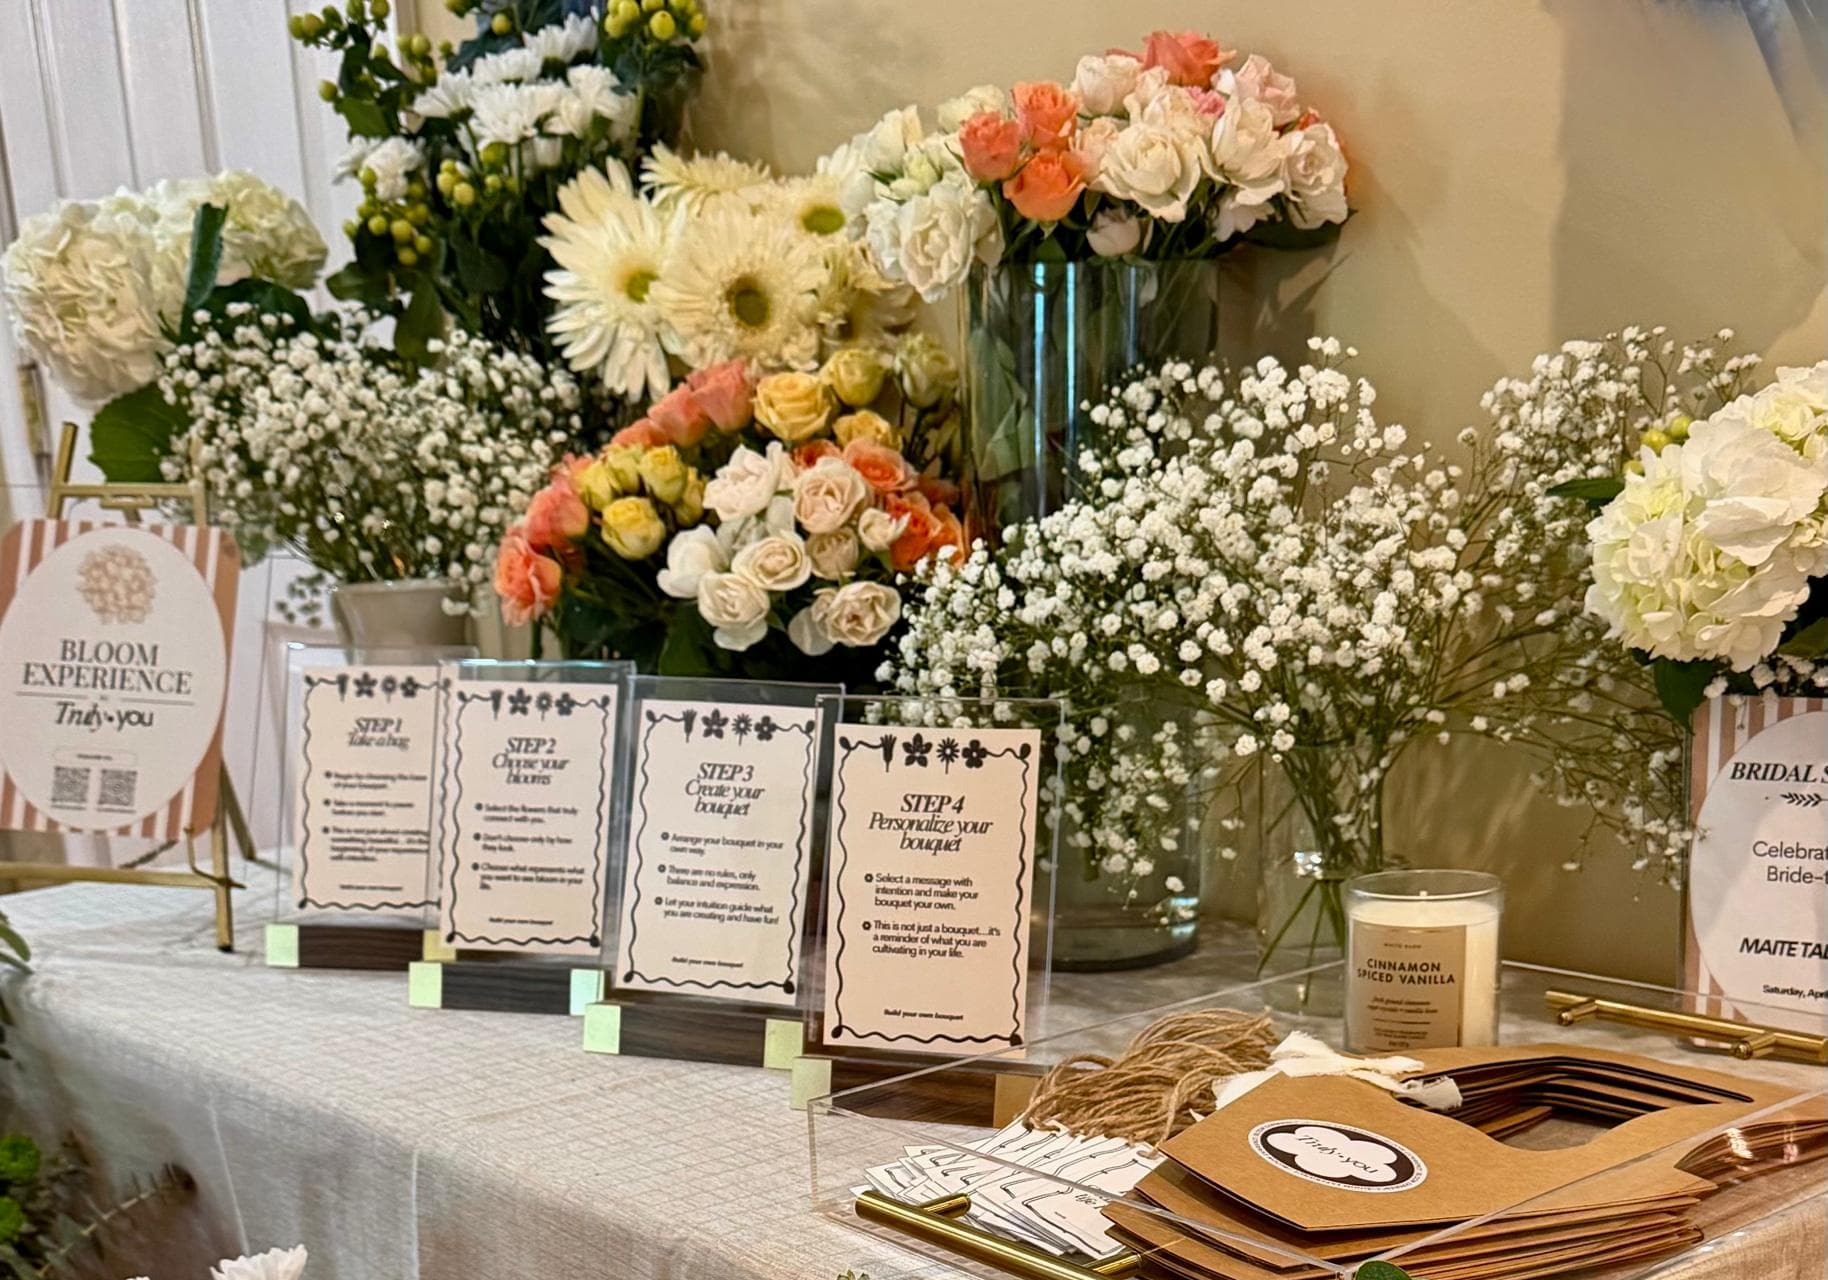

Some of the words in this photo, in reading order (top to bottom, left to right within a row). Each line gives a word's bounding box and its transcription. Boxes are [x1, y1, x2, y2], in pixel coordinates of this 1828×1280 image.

[60, 638, 158, 666] BLOOM
[22, 662, 193, 694] EXPERIENCE
[355, 716, 394, 733] STEP
[505, 736, 547, 754] STEP
[546, 737, 556, 754] 2
[492, 752, 538, 769] Choose
[538, 759, 570, 772] your
[506, 768, 552, 785] blooms
[698, 762, 743, 780] STEP
[742, 765, 754, 782] 3
[1730, 761, 1818, 783] BRIDAL
[685, 778, 731, 797] Create
[731, 786, 766, 802] your
[695, 796, 750, 819] bouquet
[900, 794, 952, 813] STEP
[952, 796, 965, 814] 4
[868, 812, 954, 834] Personalize
[954, 820, 993, 838] your
[672, 834, 703, 846] Arrange
[704, 837, 720, 846] your
[722, 836, 756, 849] bouquet
[764, 842, 784, 850] your
[900, 832, 962, 856] bouquet
[668, 865, 689, 875] There
[691, 868, 702, 876] are
[738, 871, 756, 881] only
[876, 873, 903, 882] Select
[912, 876, 951, 888] message
[953, 877, 972, 886] with
[667, 876, 698, 886] balance
[699, 878, 715, 888] and
[876, 886, 913, 896] intention
[915, 888, 932, 897] and
[934, 888, 958, 898] make
[958, 892, 978, 900] your
[665, 898, 678, 906] Let
[678, 900, 694, 908] your
[696, 900, 728, 910] intuition
[729, 903, 752, 913] guide
[753, 905, 773, 914] what
[875, 896, 912, 910] bouquet
[914, 900, 932, 910] your
[934, 902, 956, 910] own.
[664, 910, 678, 918] you
[694, 911, 725, 923] creating
[727, 914, 742, 922] and
[744, 914, 762, 924] have
[874, 920, 891, 930] This
[892, 920, 899, 930] is
[900, 923, 915, 932] not
[916, 922, 932, 934] just
[872, 944, 916, 958] cultivating
[918, 946, 926, 956] in
[928, 948, 948, 958] your
[880, 934, 918, 943] reminder
[920, 934, 930, 944] of
[931, 936, 953, 945] what
[954, 940, 971, 951] you
[1739, 937, 1799, 957] MAITE
[1366, 958, 1440, 972] CINNAMON
[1357, 968, 1394, 984] SPICED
[1399, 974, 1455, 984] VANILLA
[1762, 984, 1806, 998] Saturday,
[884, 1008, 901, 1016] Build
[935, 1012, 964, 1020] bouquet
